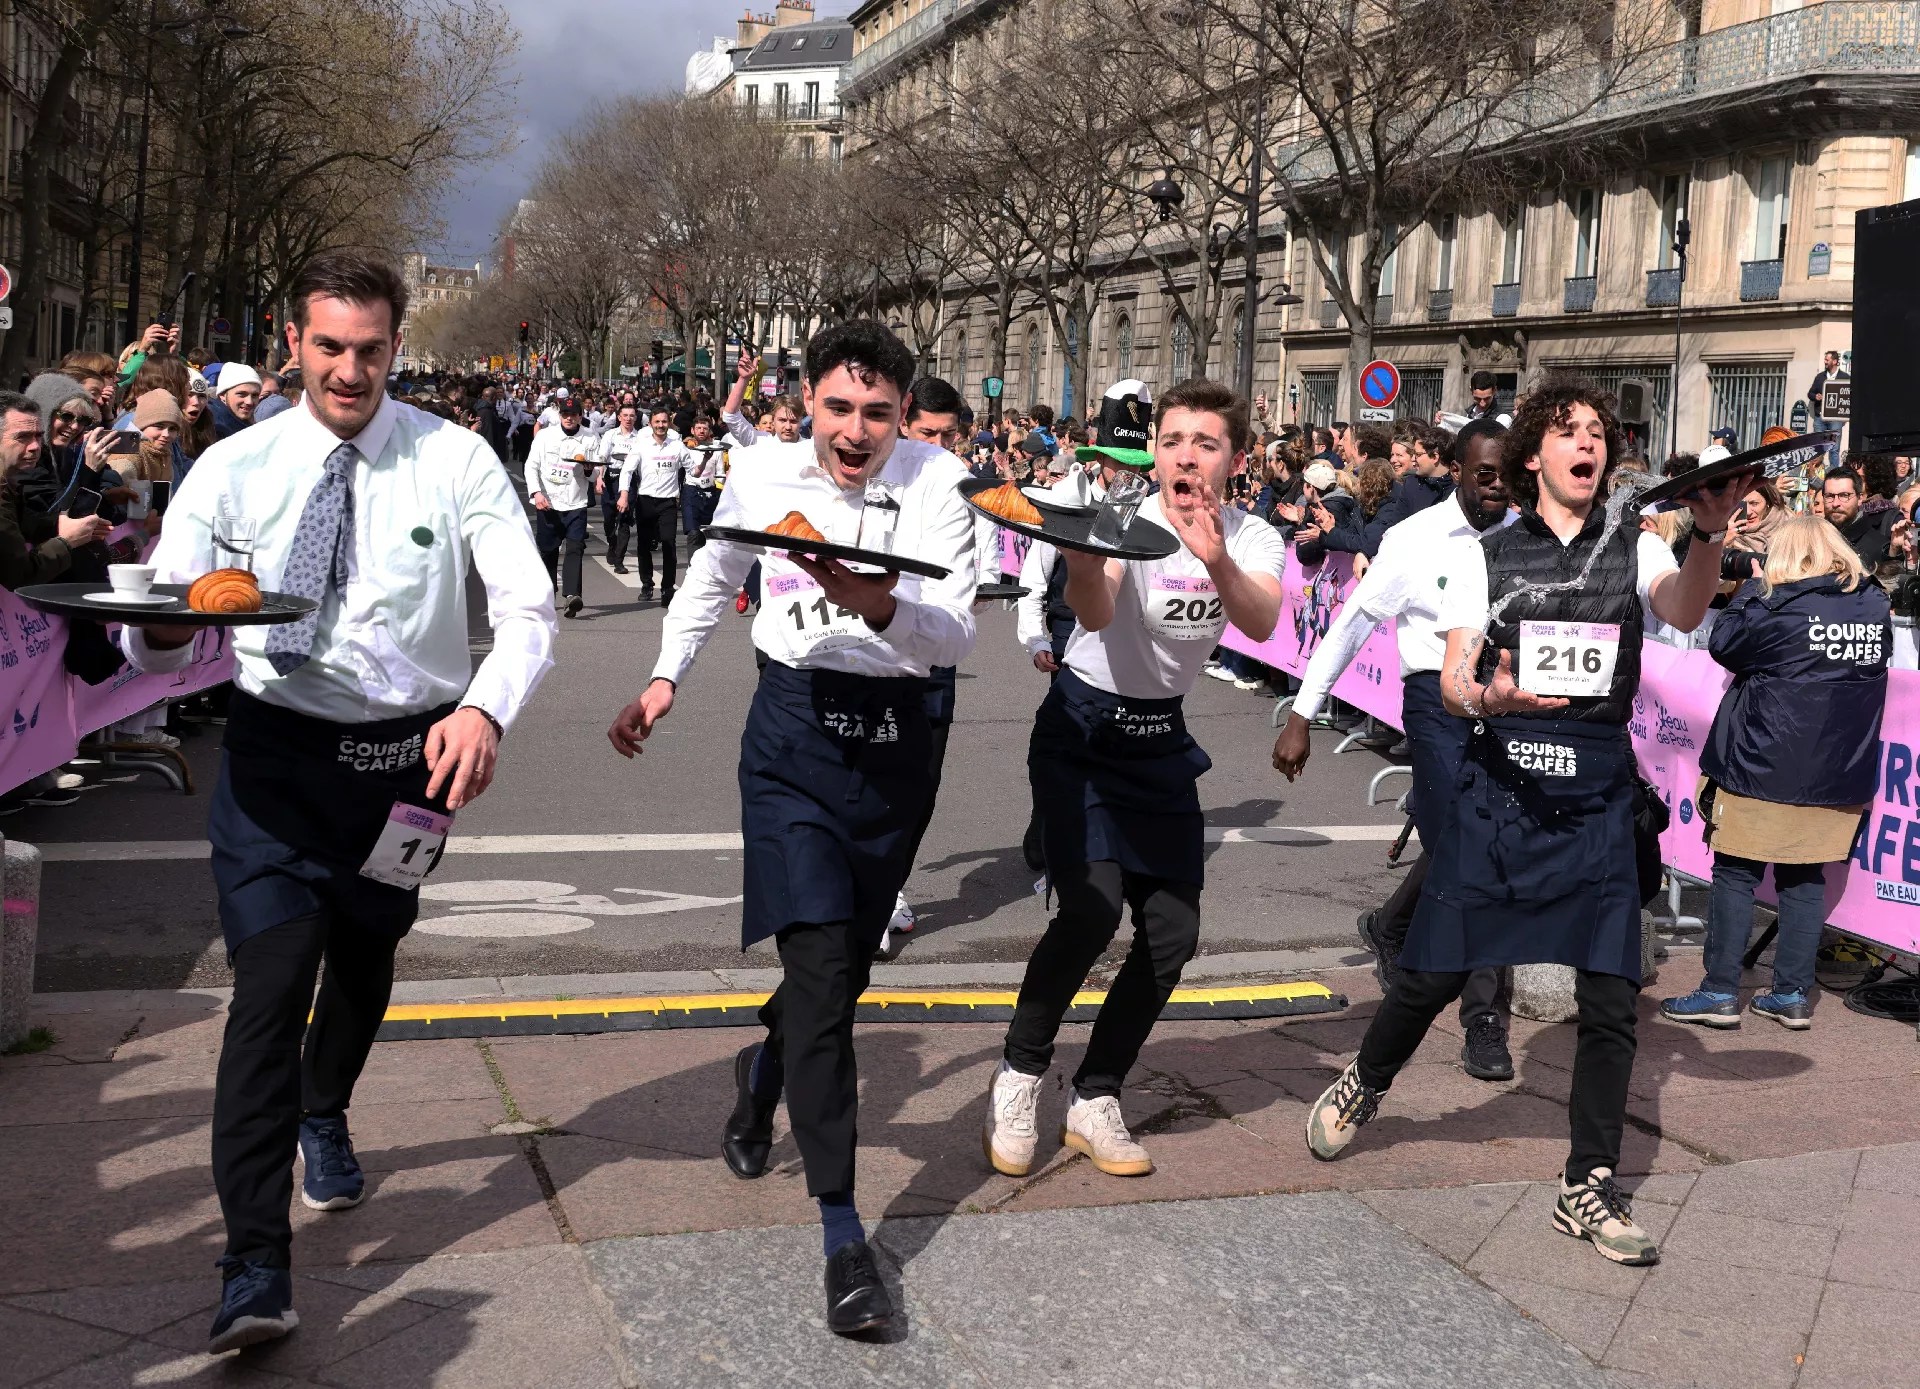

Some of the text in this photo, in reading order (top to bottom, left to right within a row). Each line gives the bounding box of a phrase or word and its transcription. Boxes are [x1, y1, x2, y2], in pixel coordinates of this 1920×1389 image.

[551, 469, 569, 479] 212
[657, 461, 672, 469] 148
[1163, 598, 1222, 621] 202
[1808, 615, 1821, 623] LA
[1808, 623, 1884, 642] COURSE
[1809, 643, 1827, 651] DES
[1536, 645, 1602, 674] 216
[1629, 720, 1647, 740] PARIS
[339, 733, 423, 757] COURSE
[1507, 740, 1577, 759] COURSE
[337, 754, 354, 763] DES
[406, 810, 435, 824] COURSE
[1876, 881, 1918, 902] PAR EAU
